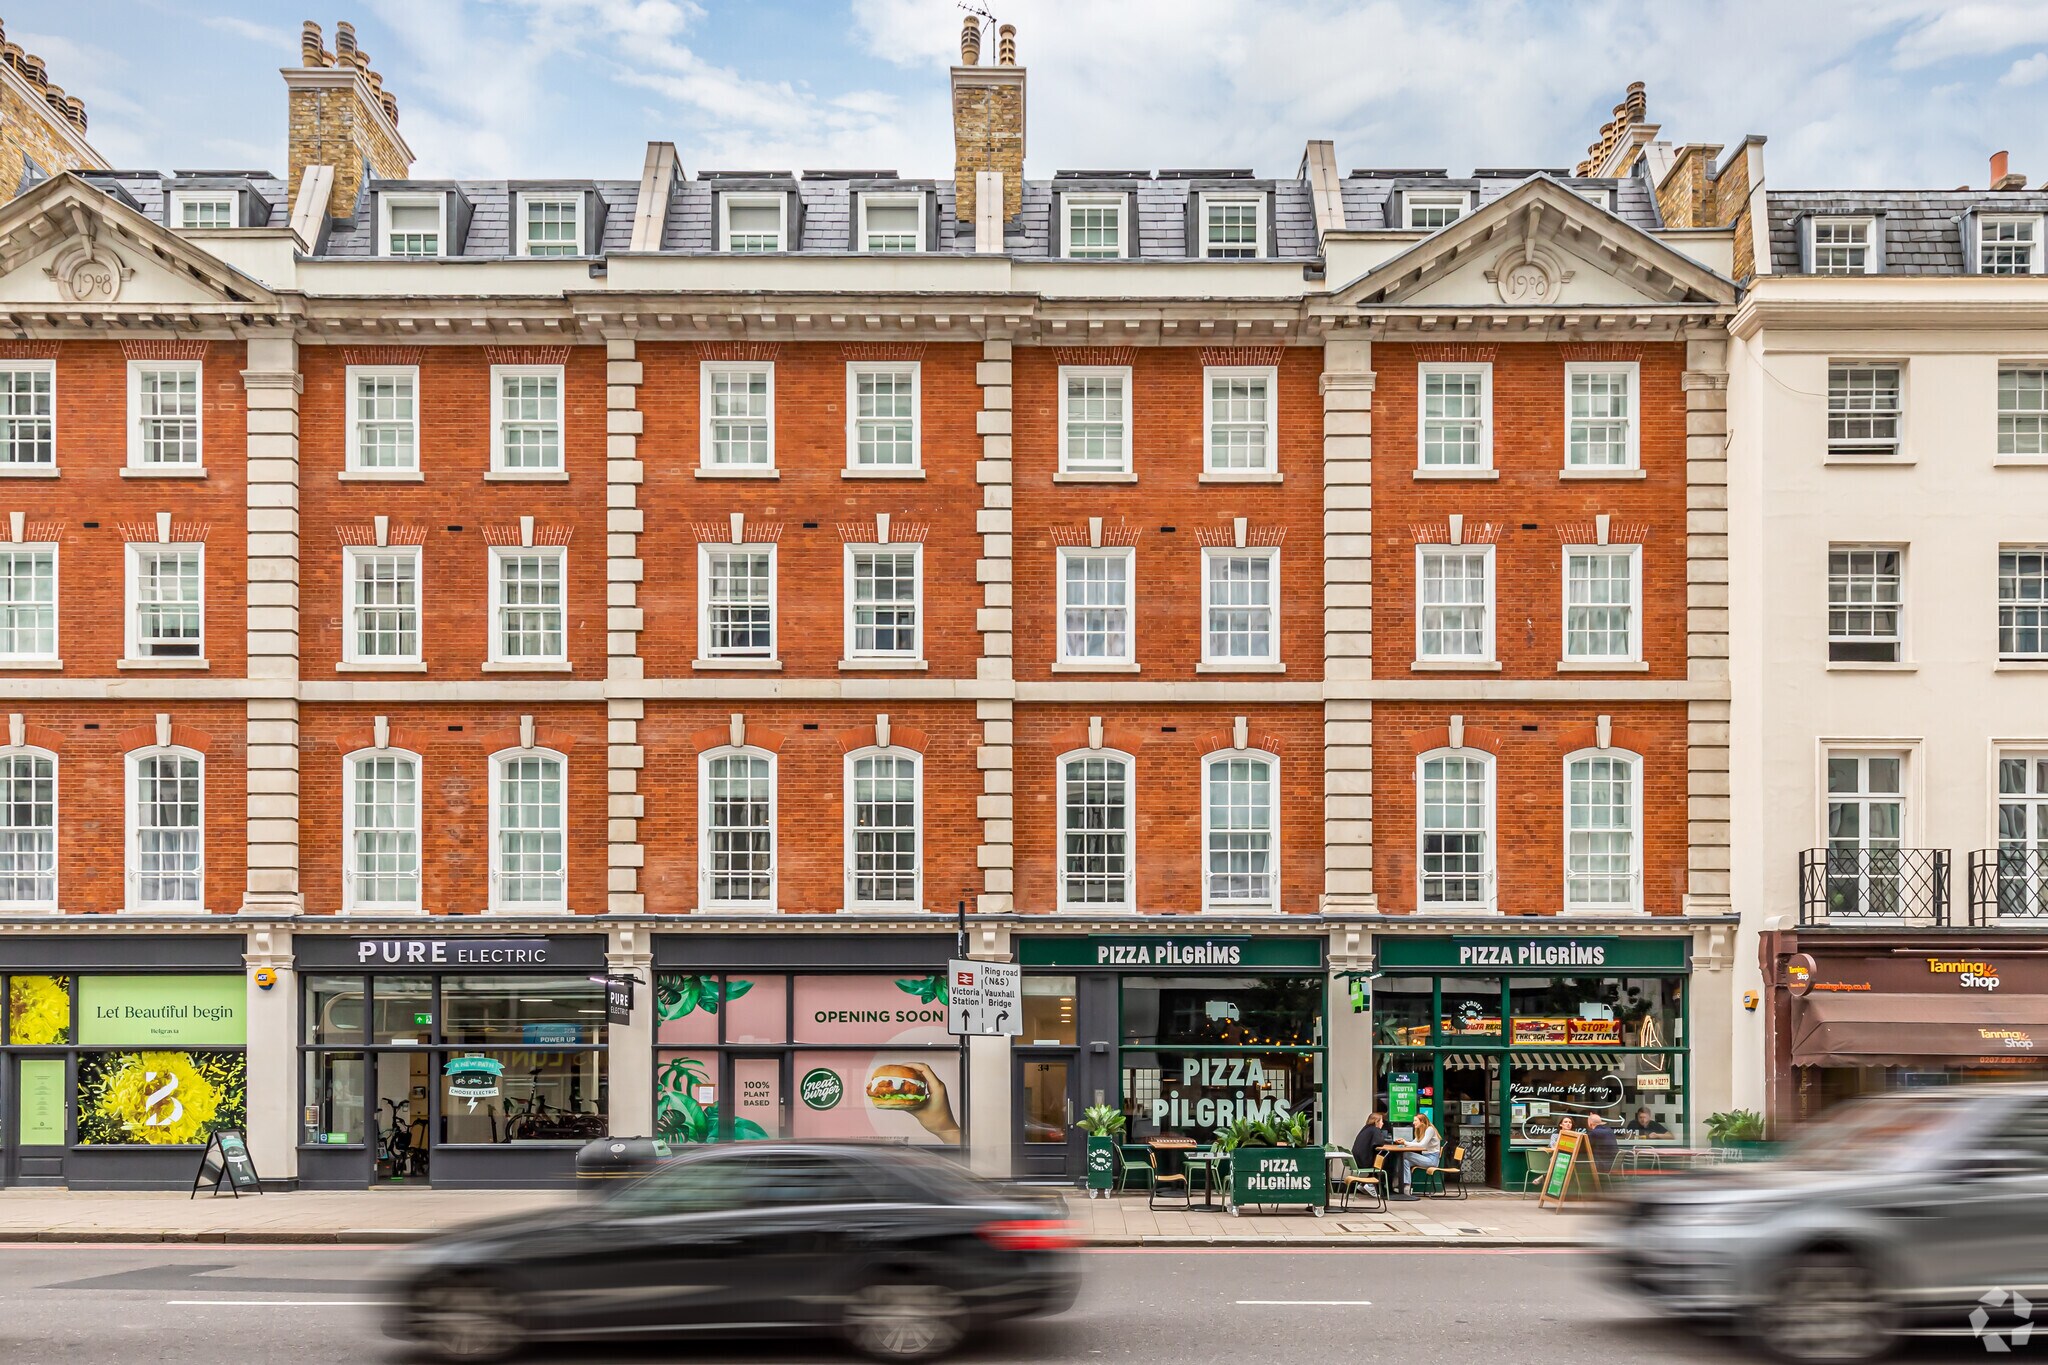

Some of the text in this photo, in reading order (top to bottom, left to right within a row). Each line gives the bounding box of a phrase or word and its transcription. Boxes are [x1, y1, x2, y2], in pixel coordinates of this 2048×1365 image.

[77, 273, 112, 298] 1908
[1511, 274, 1545, 300] 1908
[358, 941, 546, 963] PURE ELECTRIC
[1098, 946, 1150, 964] PIZZA
[1460, 946, 1513, 965] PIZZA
[984, 966, 1019, 977] Ring road
[1927, 958, 1984, 977] Tanning
[984, 976, 1010, 987] (N&S)
[1960, 972, 2000, 991] Shop
[951, 986, 980, 997] Victoria
[984, 988, 1015, 998] Vauxhall
[610, 991, 629, 1007] PURE
[952, 996, 980, 1006] Station
[988, 998, 1012, 1009] Bridge
[97, 1005, 233, 1022] Let Beautiful begin
[610, 1006, 629, 1016] ELECTRIC
[814, 1010, 944, 1023] OPENING SOON
[1581, 1023, 1609, 1032] STOP!
[1978, 1028, 2021, 1041] Tanning
[2004, 1038, 2034, 1051] Shop
[460, 1060, 477, 1068] NEW
[477, 1061, 495, 1069] PATH
[1183, 1058, 1265, 1086] PIZZA
[744, 1081, 770, 1089] 100%
[806, 1075, 836, 1091] neat
[450, 1088, 472, 1096] CHOOSE
[804, 1084, 840, 1102] burger
[1509, 1083, 1612, 1100] Pizza palace this way.
[1530, 1124, 1557, 1134] Other
[1260, 1159, 1299, 1172] PIZZA
